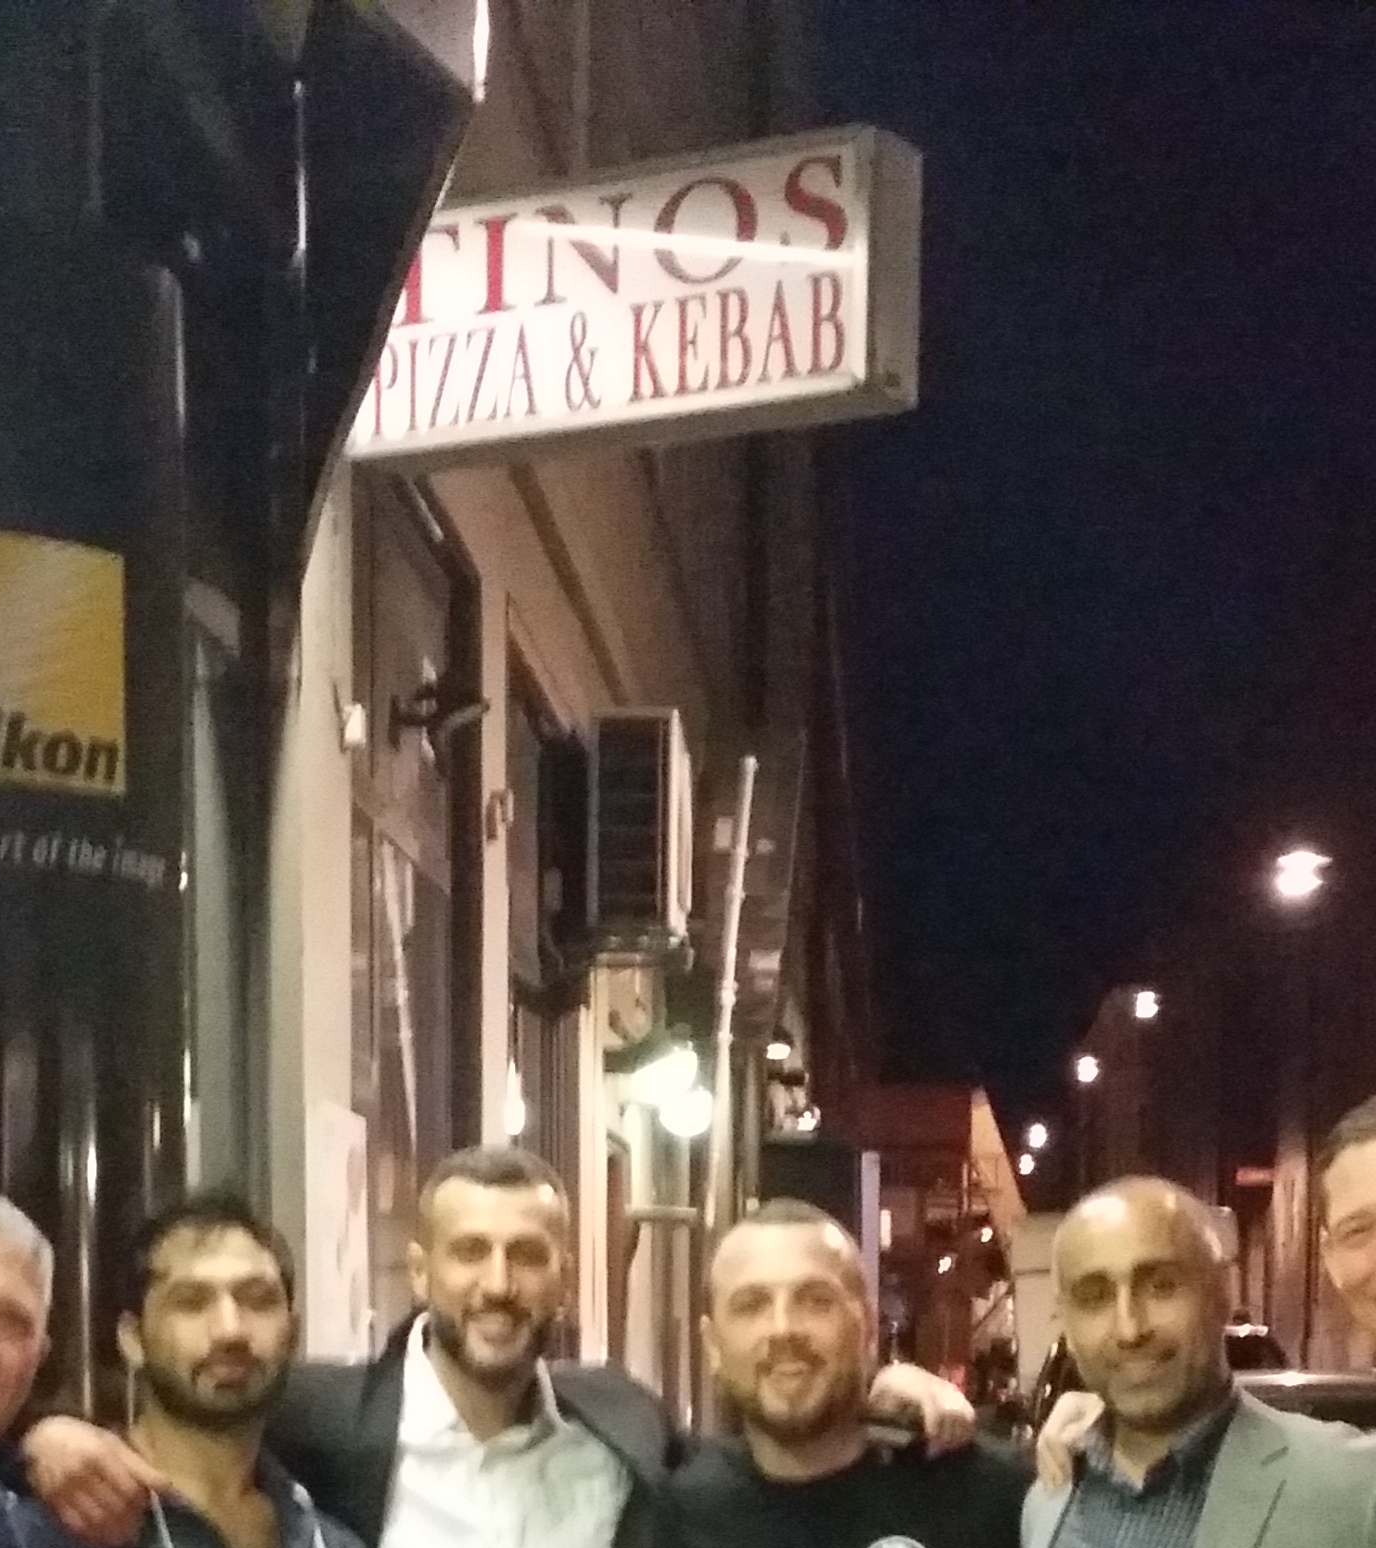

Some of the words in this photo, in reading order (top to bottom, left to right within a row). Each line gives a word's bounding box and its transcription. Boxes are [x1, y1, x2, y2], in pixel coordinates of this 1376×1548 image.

[372, 322, 537, 436] PIZZA
[564, 310, 603, 412] &
[629, 271, 845, 402] KEBAB
[68, 835, 107, 874] the
